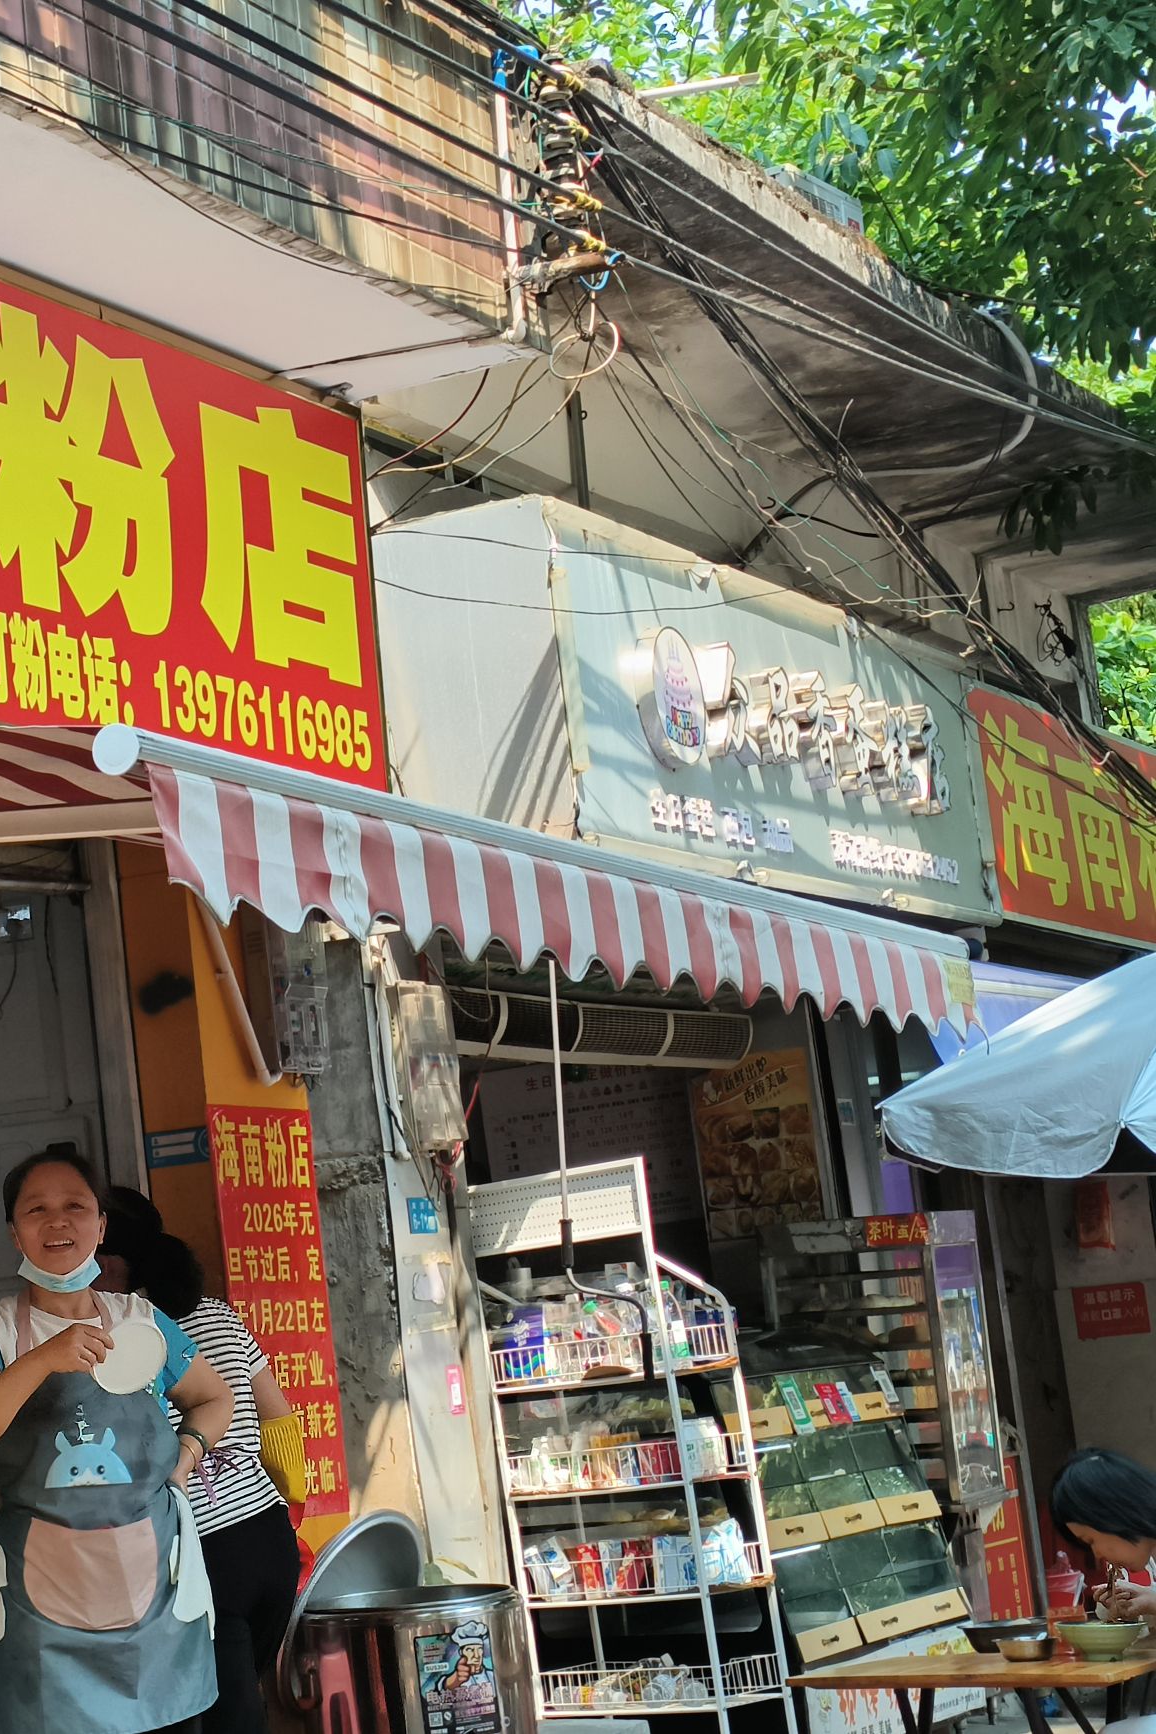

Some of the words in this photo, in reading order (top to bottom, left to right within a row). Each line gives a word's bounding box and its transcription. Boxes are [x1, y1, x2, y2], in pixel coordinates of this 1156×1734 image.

[214, 1115, 311, 1189] 海南粉店
[243, 1202, 315, 1236] 2026年元
[1084, 1287, 1136, 1305] 温馨提示
[265, 1351, 333, 1389] 店开业，
